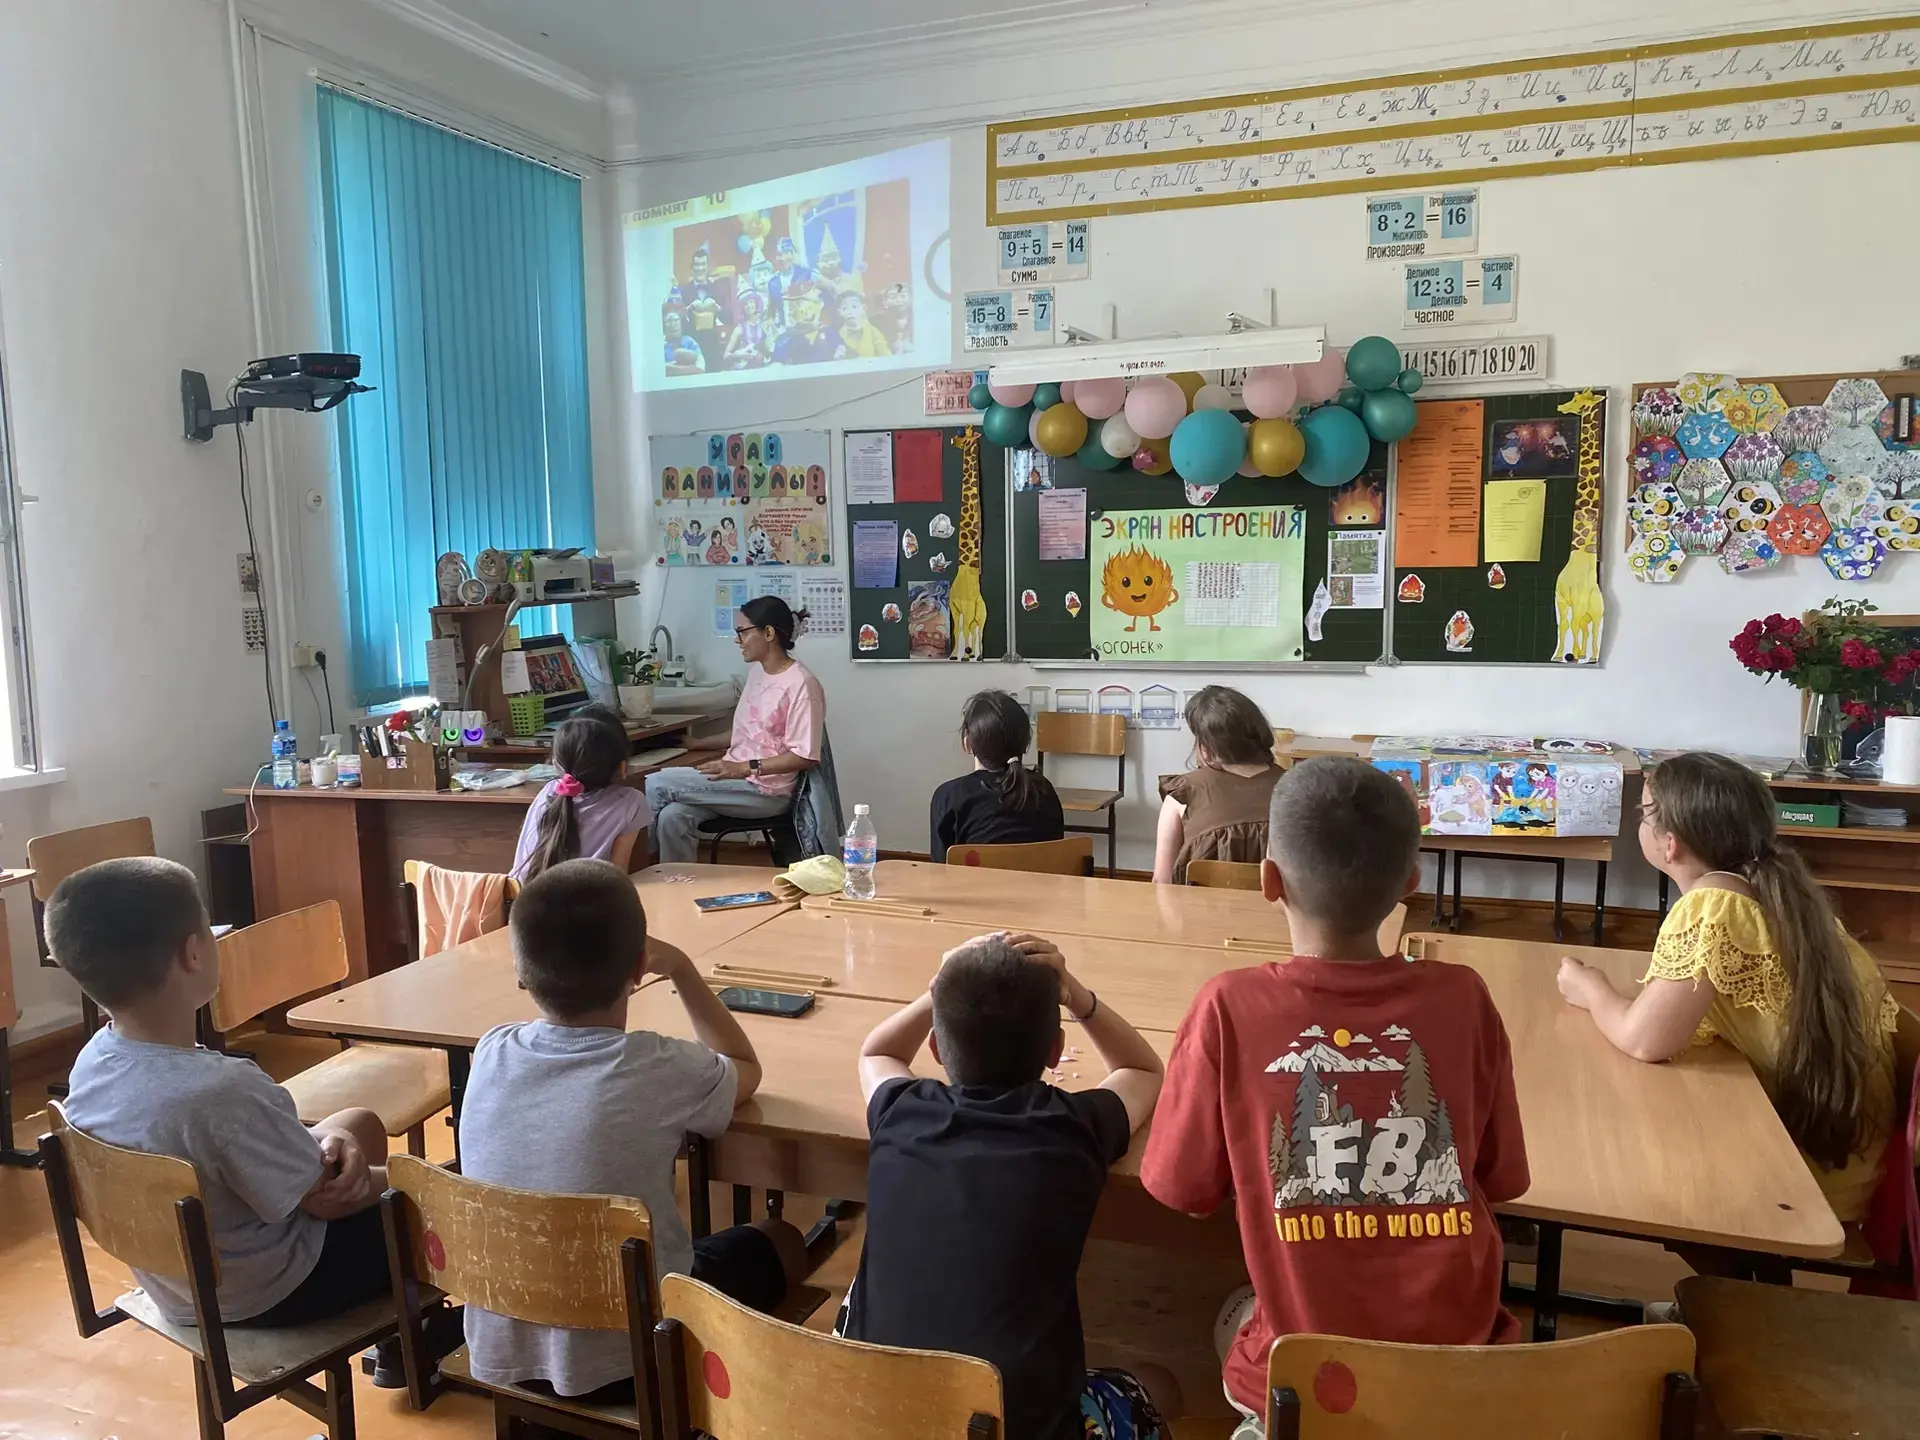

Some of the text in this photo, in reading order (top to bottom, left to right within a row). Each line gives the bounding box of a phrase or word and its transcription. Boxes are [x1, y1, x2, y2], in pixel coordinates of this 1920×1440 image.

[1366, 202, 1402, 213] Множитель
[1447, 207, 1466, 225] 16
[999, 229, 1032, 240] Слагаемое
[1067, 224, 1087, 234] Сумма
[1392, 230, 1428, 242] Множитель
[1068, 236, 1084, 253] 14
[1367, 242, 1425, 259] Произведение
[1022, 255, 1056, 266] Слагаемое
[1481, 261, 1513, 272] Частное
[1012, 270, 1037, 282] Сумма
[1406, 267, 1439, 280] Делимое
[1491, 274, 1503, 291] 4
[1028, 293, 1054, 303] Разность
[1430, 295, 1468, 307] Делитель
[1038, 304, 1047, 319] 7
[1414, 310, 1454, 323] Частное
[971, 335, 1009, 348] Разность
[1423, 351, 1438, 377] 15
[1441, 349, 1457, 376] 16
[1461, 349, 1477, 375] 17
[1482, 347, 1498, 374] 18
[1501, 346, 1516, 372] 19
[1519, 344, 1535, 371] 20
[711, 442, 775, 460] УРА!
[665, 472, 818, 491] КАНИКУЛЫ!
[1101, 515, 1161, 540] ЭКРАН
[1169, 511, 1301, 540] НАСТРОЕНИЯ
[1274, 1208, 1473, 1242] into the woods
